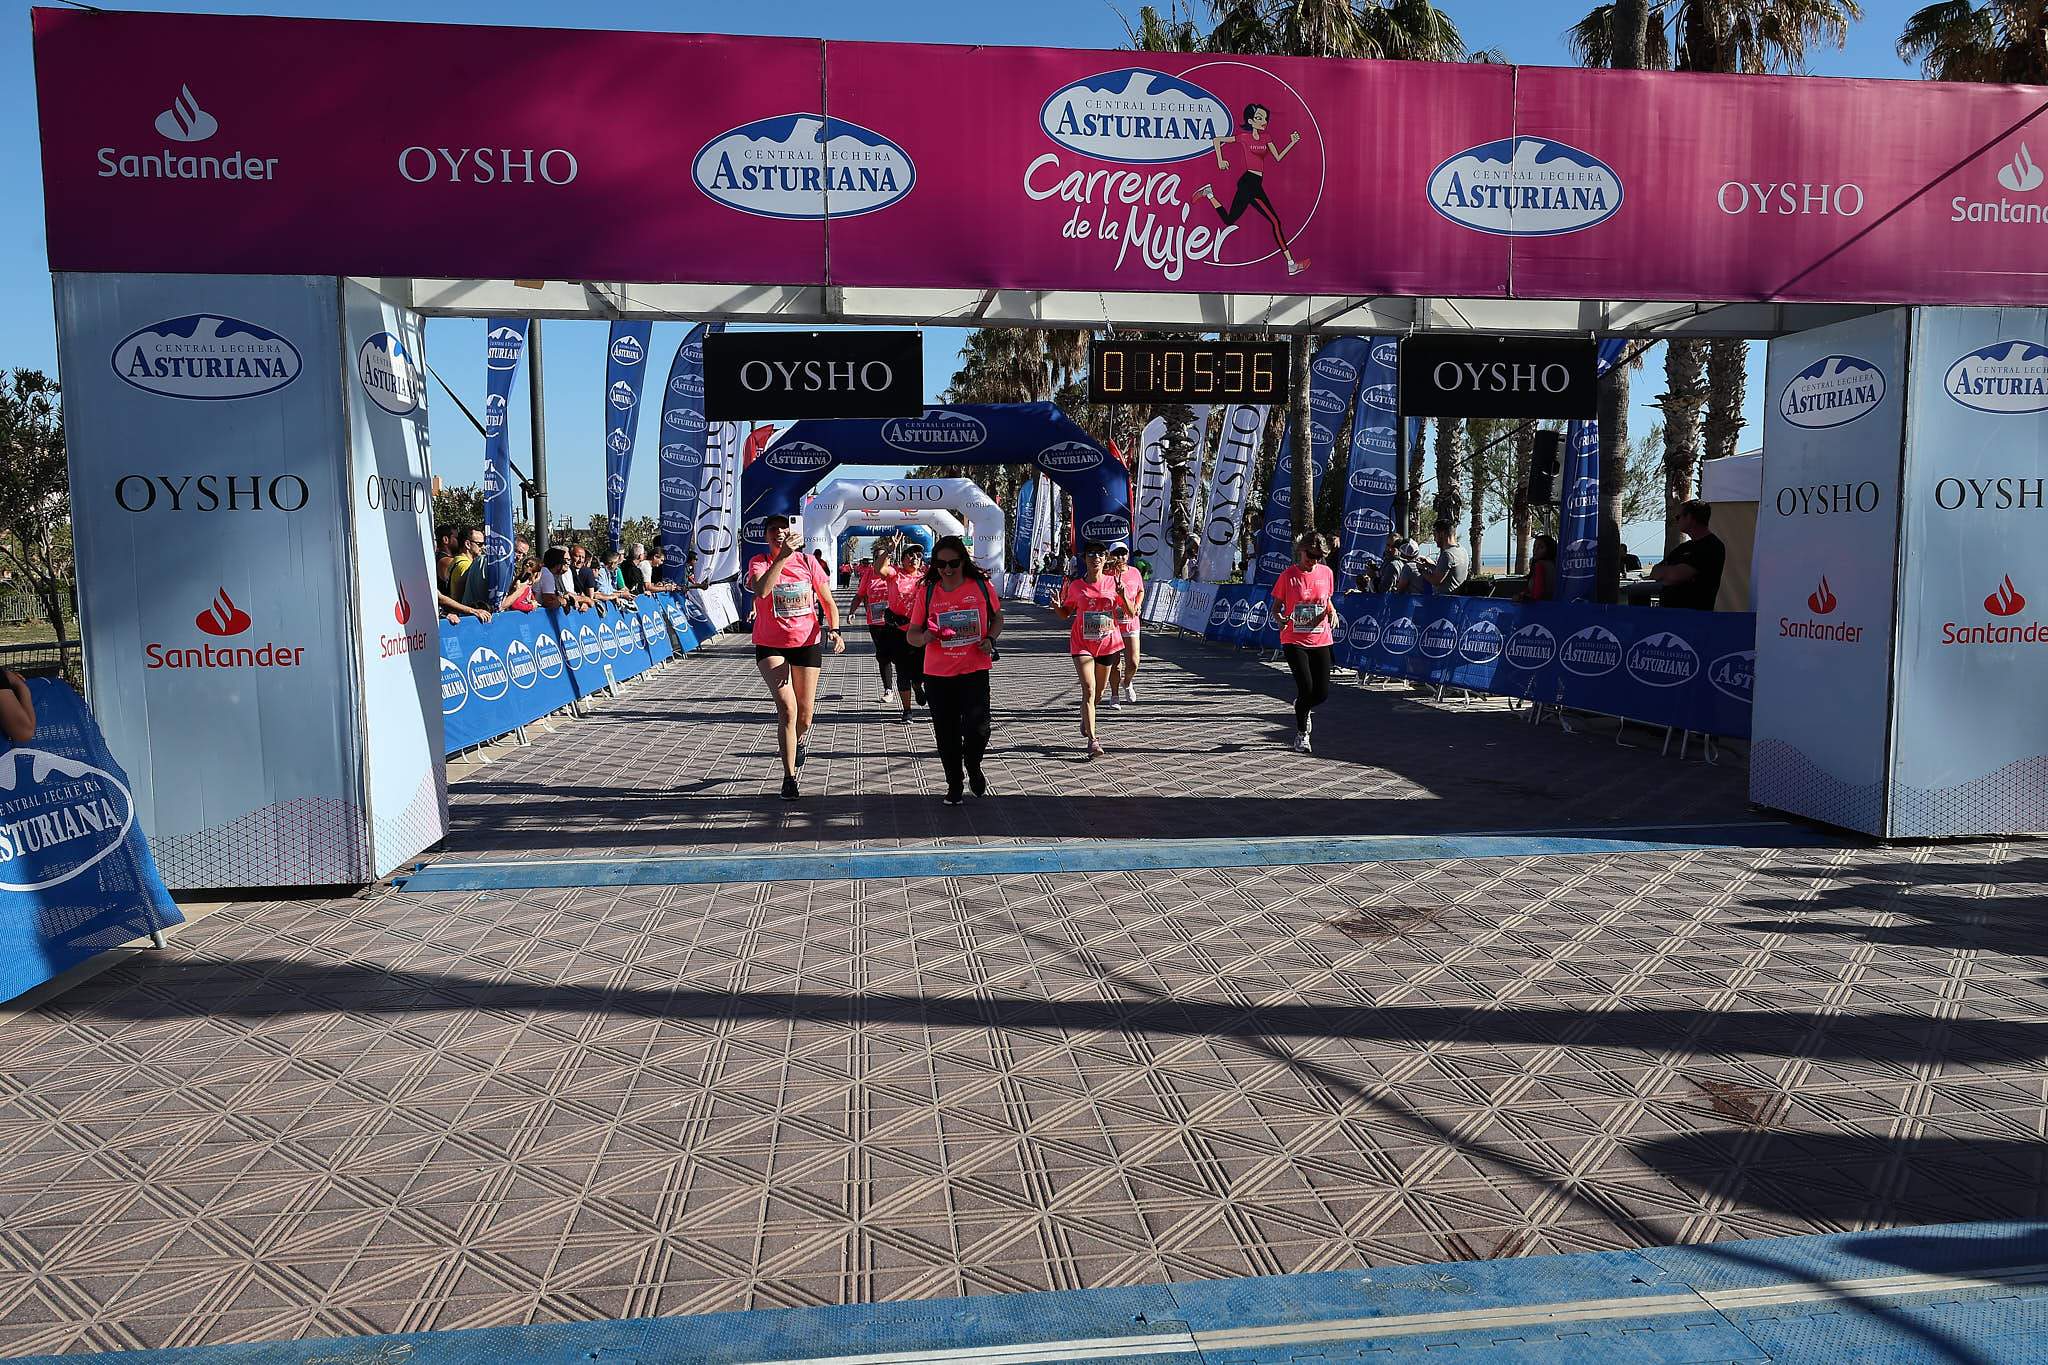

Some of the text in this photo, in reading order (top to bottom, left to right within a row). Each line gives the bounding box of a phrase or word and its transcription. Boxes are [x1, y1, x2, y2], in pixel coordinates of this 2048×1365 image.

[1055, 100, 1218, 141] ASTURIANA
[1085, 99, 1213, 113] CENTRAL LECHERA
[97, 147, 279, 180] Santander
[398, 145, 578, 185] OYSHO
[744, 149, 891, 161] CENTRAL LECHERA
[709, 150, 900, 193] ASTURIANA
[1023, 153, 1182, 206] Carrera
[1472, 169, 1603, 182] CENTRAL LECHERA
[1441, 170, 1609, 212] ASTURIANA
[1717, 181, 1865, 216] OYSHO
[1062, 202, 1240, 282] de la Mujer
[127, 345, 289, 378] ASTURIANA
[155, 343, 282, 354] CENTRAL LECHERA
[364, 358, 417, 400] ASTURIANA
[740, 360, 893, 392] OYSHO
[1103, 351, 1273, 393] 01:05:36
[1433, 361, 1570, 393] OYSHO
[1800, 373, 1874, 393] CENTRAL LECHERA
[1953, 366, 2048, 396] ASTURIA
[1975, 366, 2048, 375] CENTRAL LECH
[1785, 383, 1877, 416] ASTURIANA
[888, 423, 980, 443] ASTURIANA
[769, 452, 827, 465] ASTURIANA
[1042, 453, 1100, 466] ASTURIANA
[1207, 405, 1261, 546] OYSHO
[114, 474, 310, 513] OYSHO
[366, 474, 426, 514] OYSHO
[862, 484, 944, 502] OYSHO
[1137, 441, 1167, 556] OYSHO
[1777, 481, 1880, 517] OYSHO
[1934, 477, 2048, 511] OYSH
[1085, 525, 1129, 537] ASTURIANA
[381, 629, 427, 659] Santander
[1460, 636, 1501, 655] ASTURIANA
[1779, 617, 1864, 644] Santander
[1941, 621, 2048, 645] Santande
[145, 642, 305, 669] Santander
[1507, 638, 1551, 660] ASTURIANA
[1563, 641, 1617, 666] ASTURIANA
[1629, 649, 1691, 677] ASTURIANA
[441, 680, 467, 700] URIANA
[0, 779, 102, 816] ENTRAL LECHERA
[0, 797, 122, 864] STURIANA
